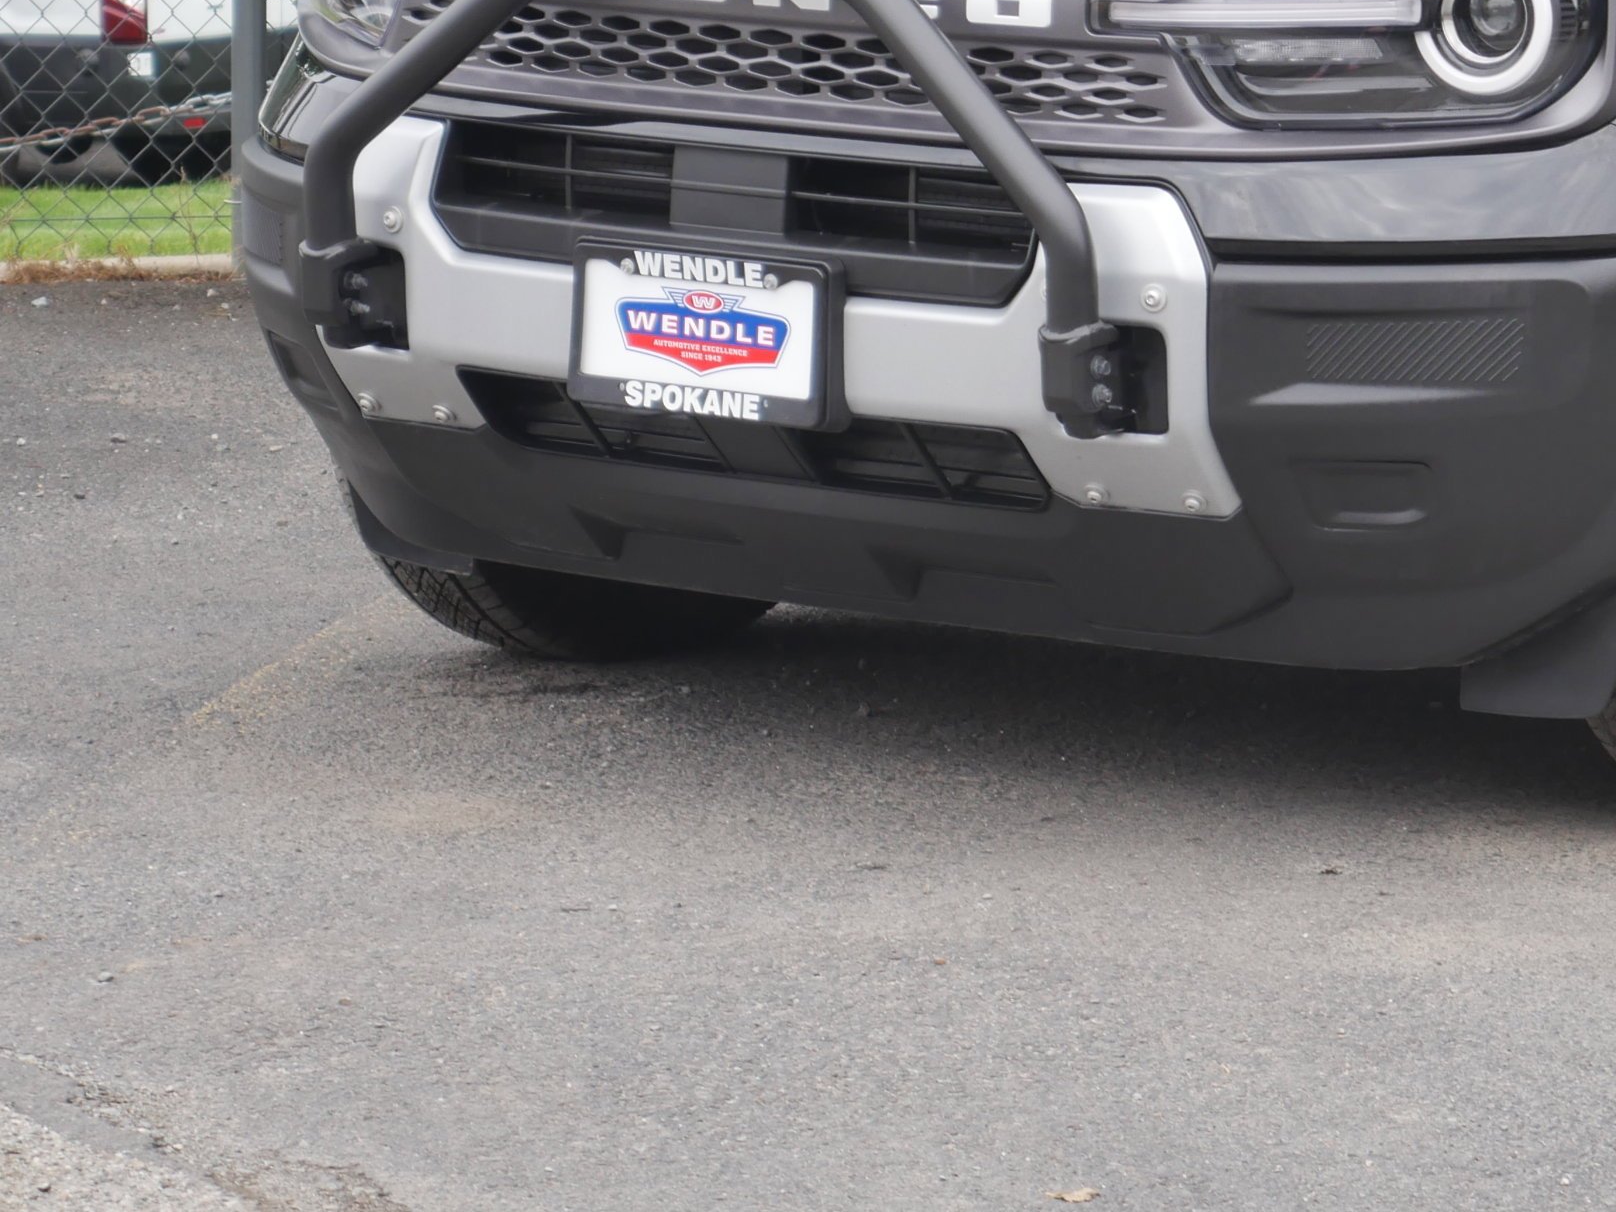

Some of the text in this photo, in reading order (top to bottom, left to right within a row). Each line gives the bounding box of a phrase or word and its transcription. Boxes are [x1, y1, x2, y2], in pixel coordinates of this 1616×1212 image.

[633, 250, 765, 288] WENDLE
[626, 309, 775, 346] WENDLE
[653, 339, 748, 357] AUTOMOTIVE EXCELLENCE
[681, 351, 703, 360] SINCE
[624, 380, 761, 421] SPOKANE
